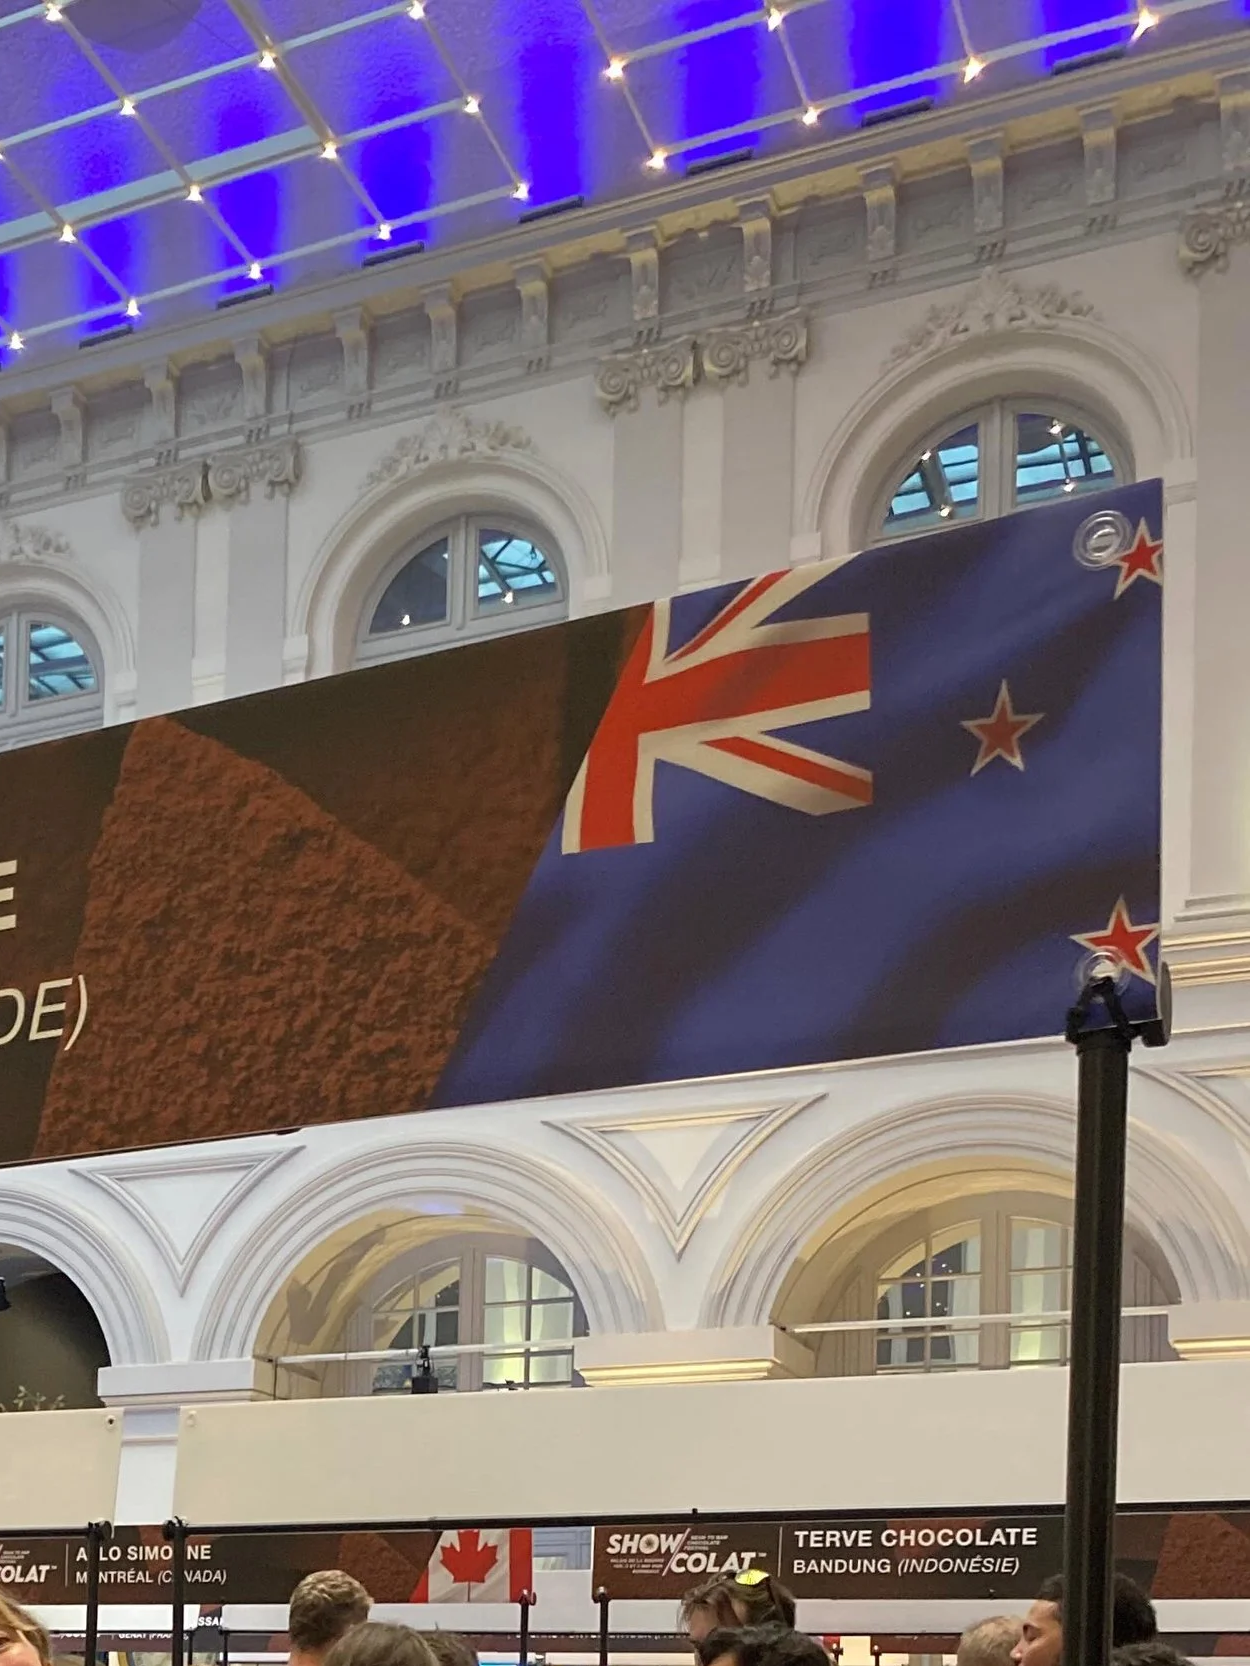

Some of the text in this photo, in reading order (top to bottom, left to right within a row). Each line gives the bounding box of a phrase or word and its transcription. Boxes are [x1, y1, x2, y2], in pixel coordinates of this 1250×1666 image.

[606, 1533, 684, 1555] SHOW
[794, 1527, 1038, 1548] TERVE CHOCOLATE
[76, 1545, 212, 1562] ALO SIMONE
[793, 1555, 1020, 1576] BANDUNG (INDONÉSIE)
[76, 1569, 227, 1586] MNTRÉAL (CNADA)
